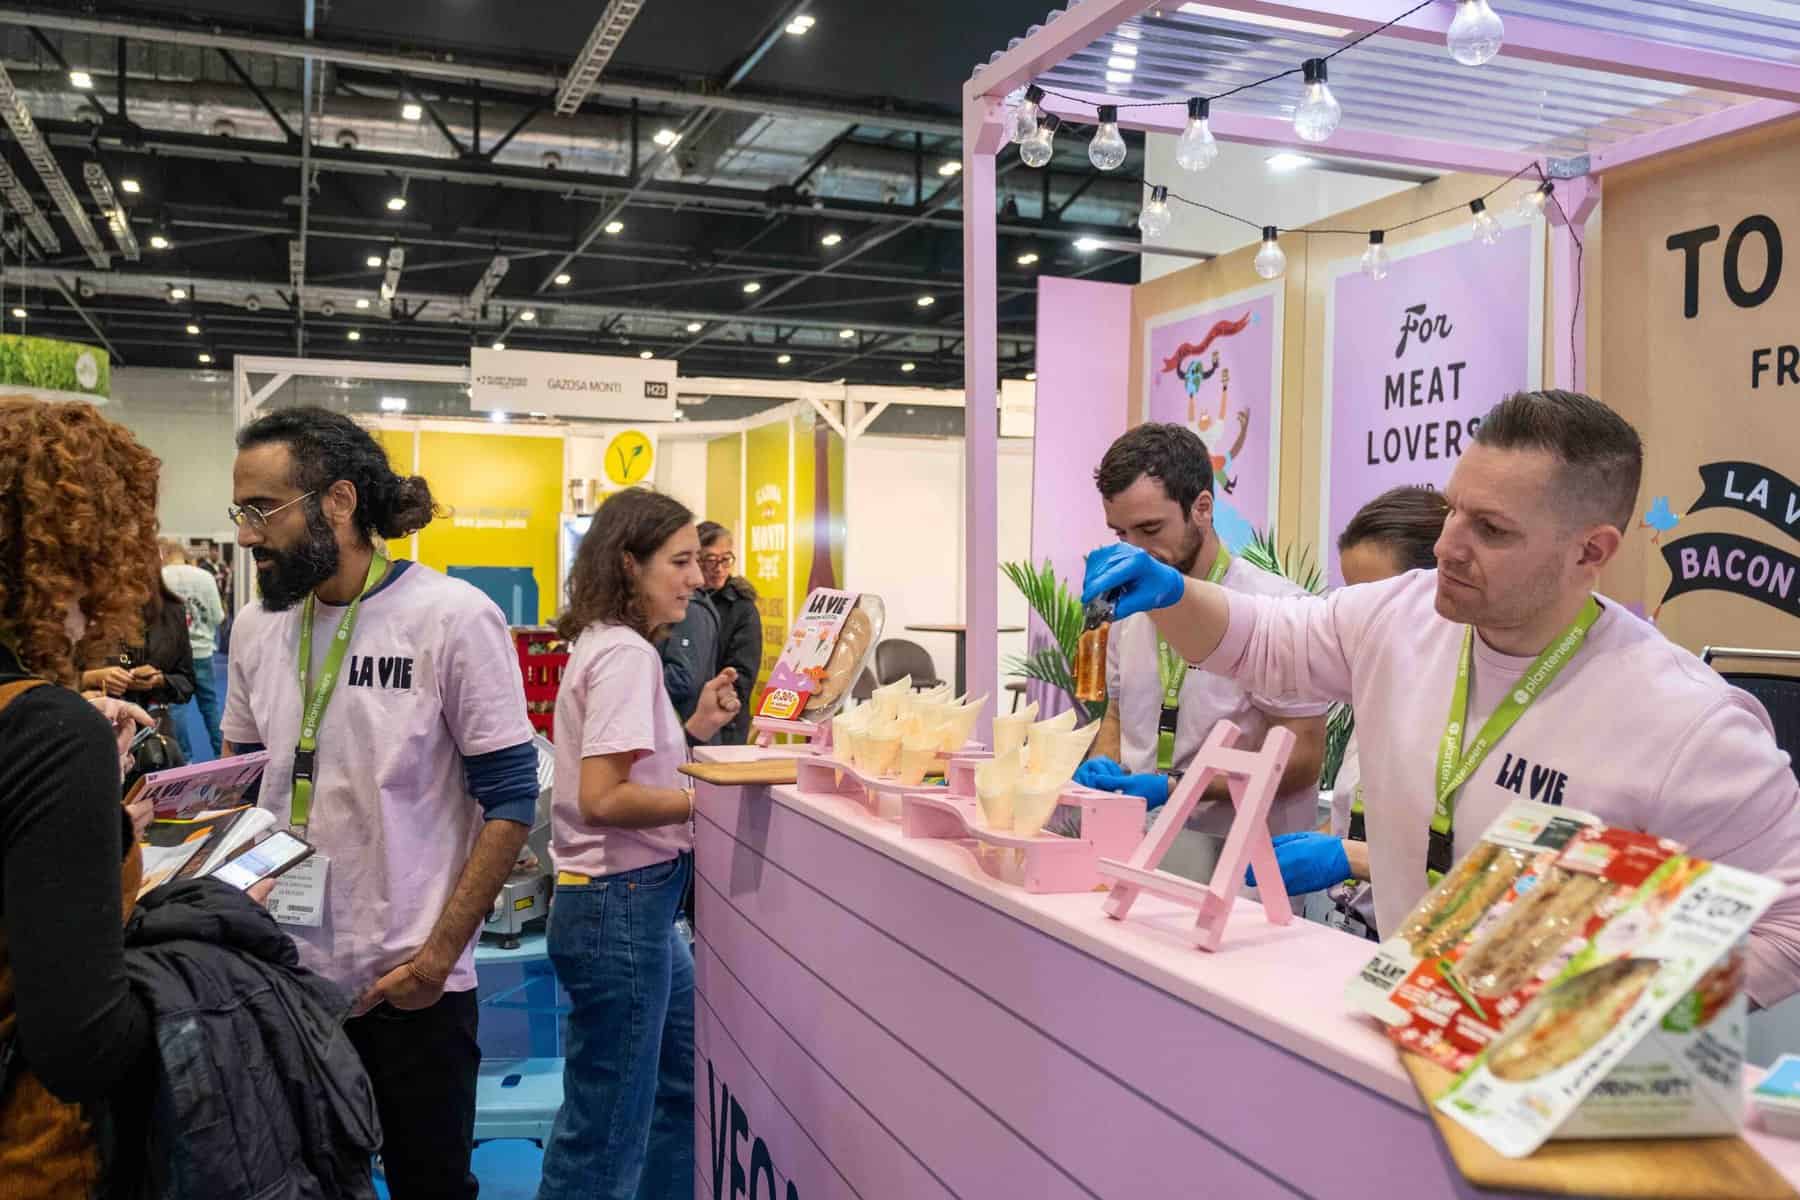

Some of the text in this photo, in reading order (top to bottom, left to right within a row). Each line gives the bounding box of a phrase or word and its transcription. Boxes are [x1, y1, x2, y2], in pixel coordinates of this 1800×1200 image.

[1666, 214, 1784, 319] TO
[1395, 303, 1453, 359] For
[547, 378, 666, 396] GAZOSA MONTI H23
[1384, 361, 1467, 411] MEAT
[1751, 345, 1800, 389] FR
[1724, 470, 1769, 510] LA
[1680, 545, 1796, 599] BACON
[808, 594, 849, 615] LA VIE
[348, 655, 414, 689] LA VIE
[1525, 626, 1586, 694] planteneers
[1495, 752, 1569, 806] LA VIE
